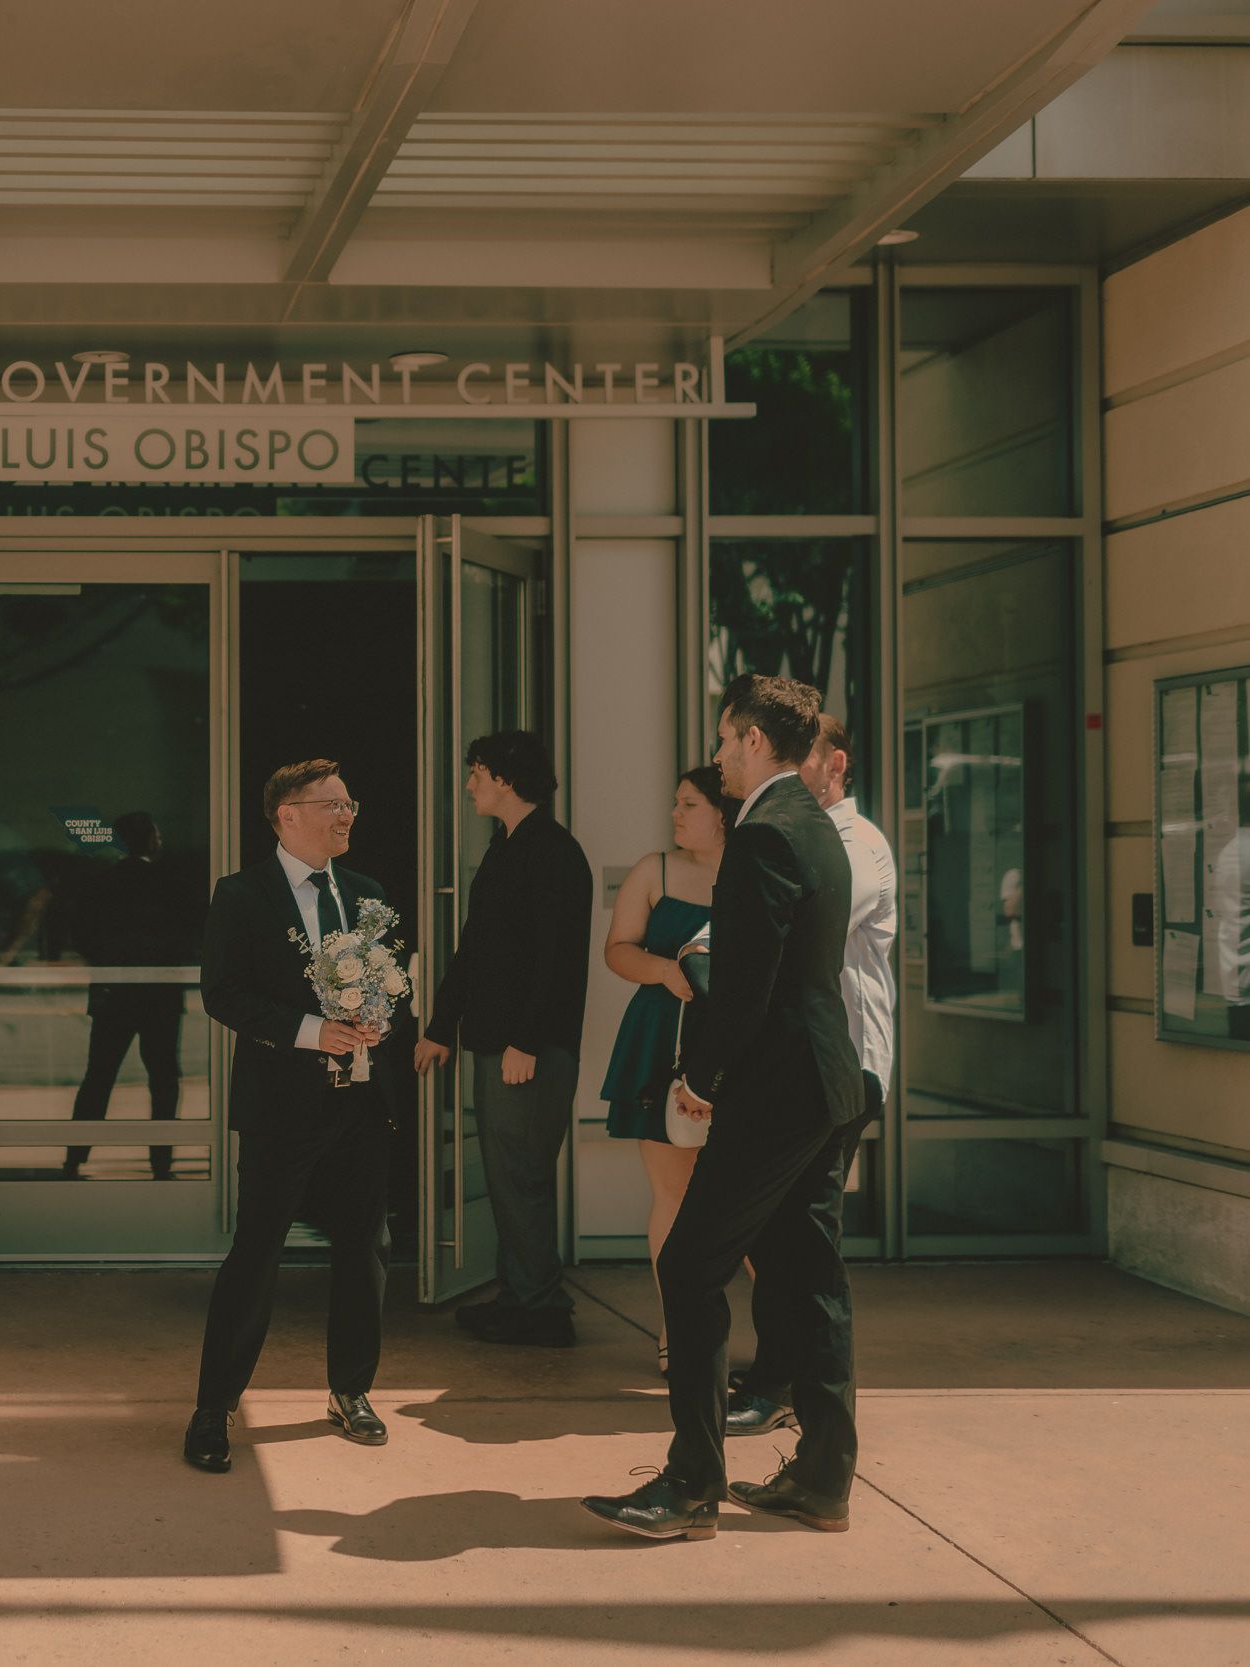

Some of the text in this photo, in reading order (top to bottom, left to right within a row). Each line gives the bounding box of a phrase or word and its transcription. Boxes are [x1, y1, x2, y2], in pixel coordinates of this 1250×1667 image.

[456, 361, 704, 405] CENTER
[1, 427, 110, 471] LUIS
[135, 428, 340, 471] OBISPO
